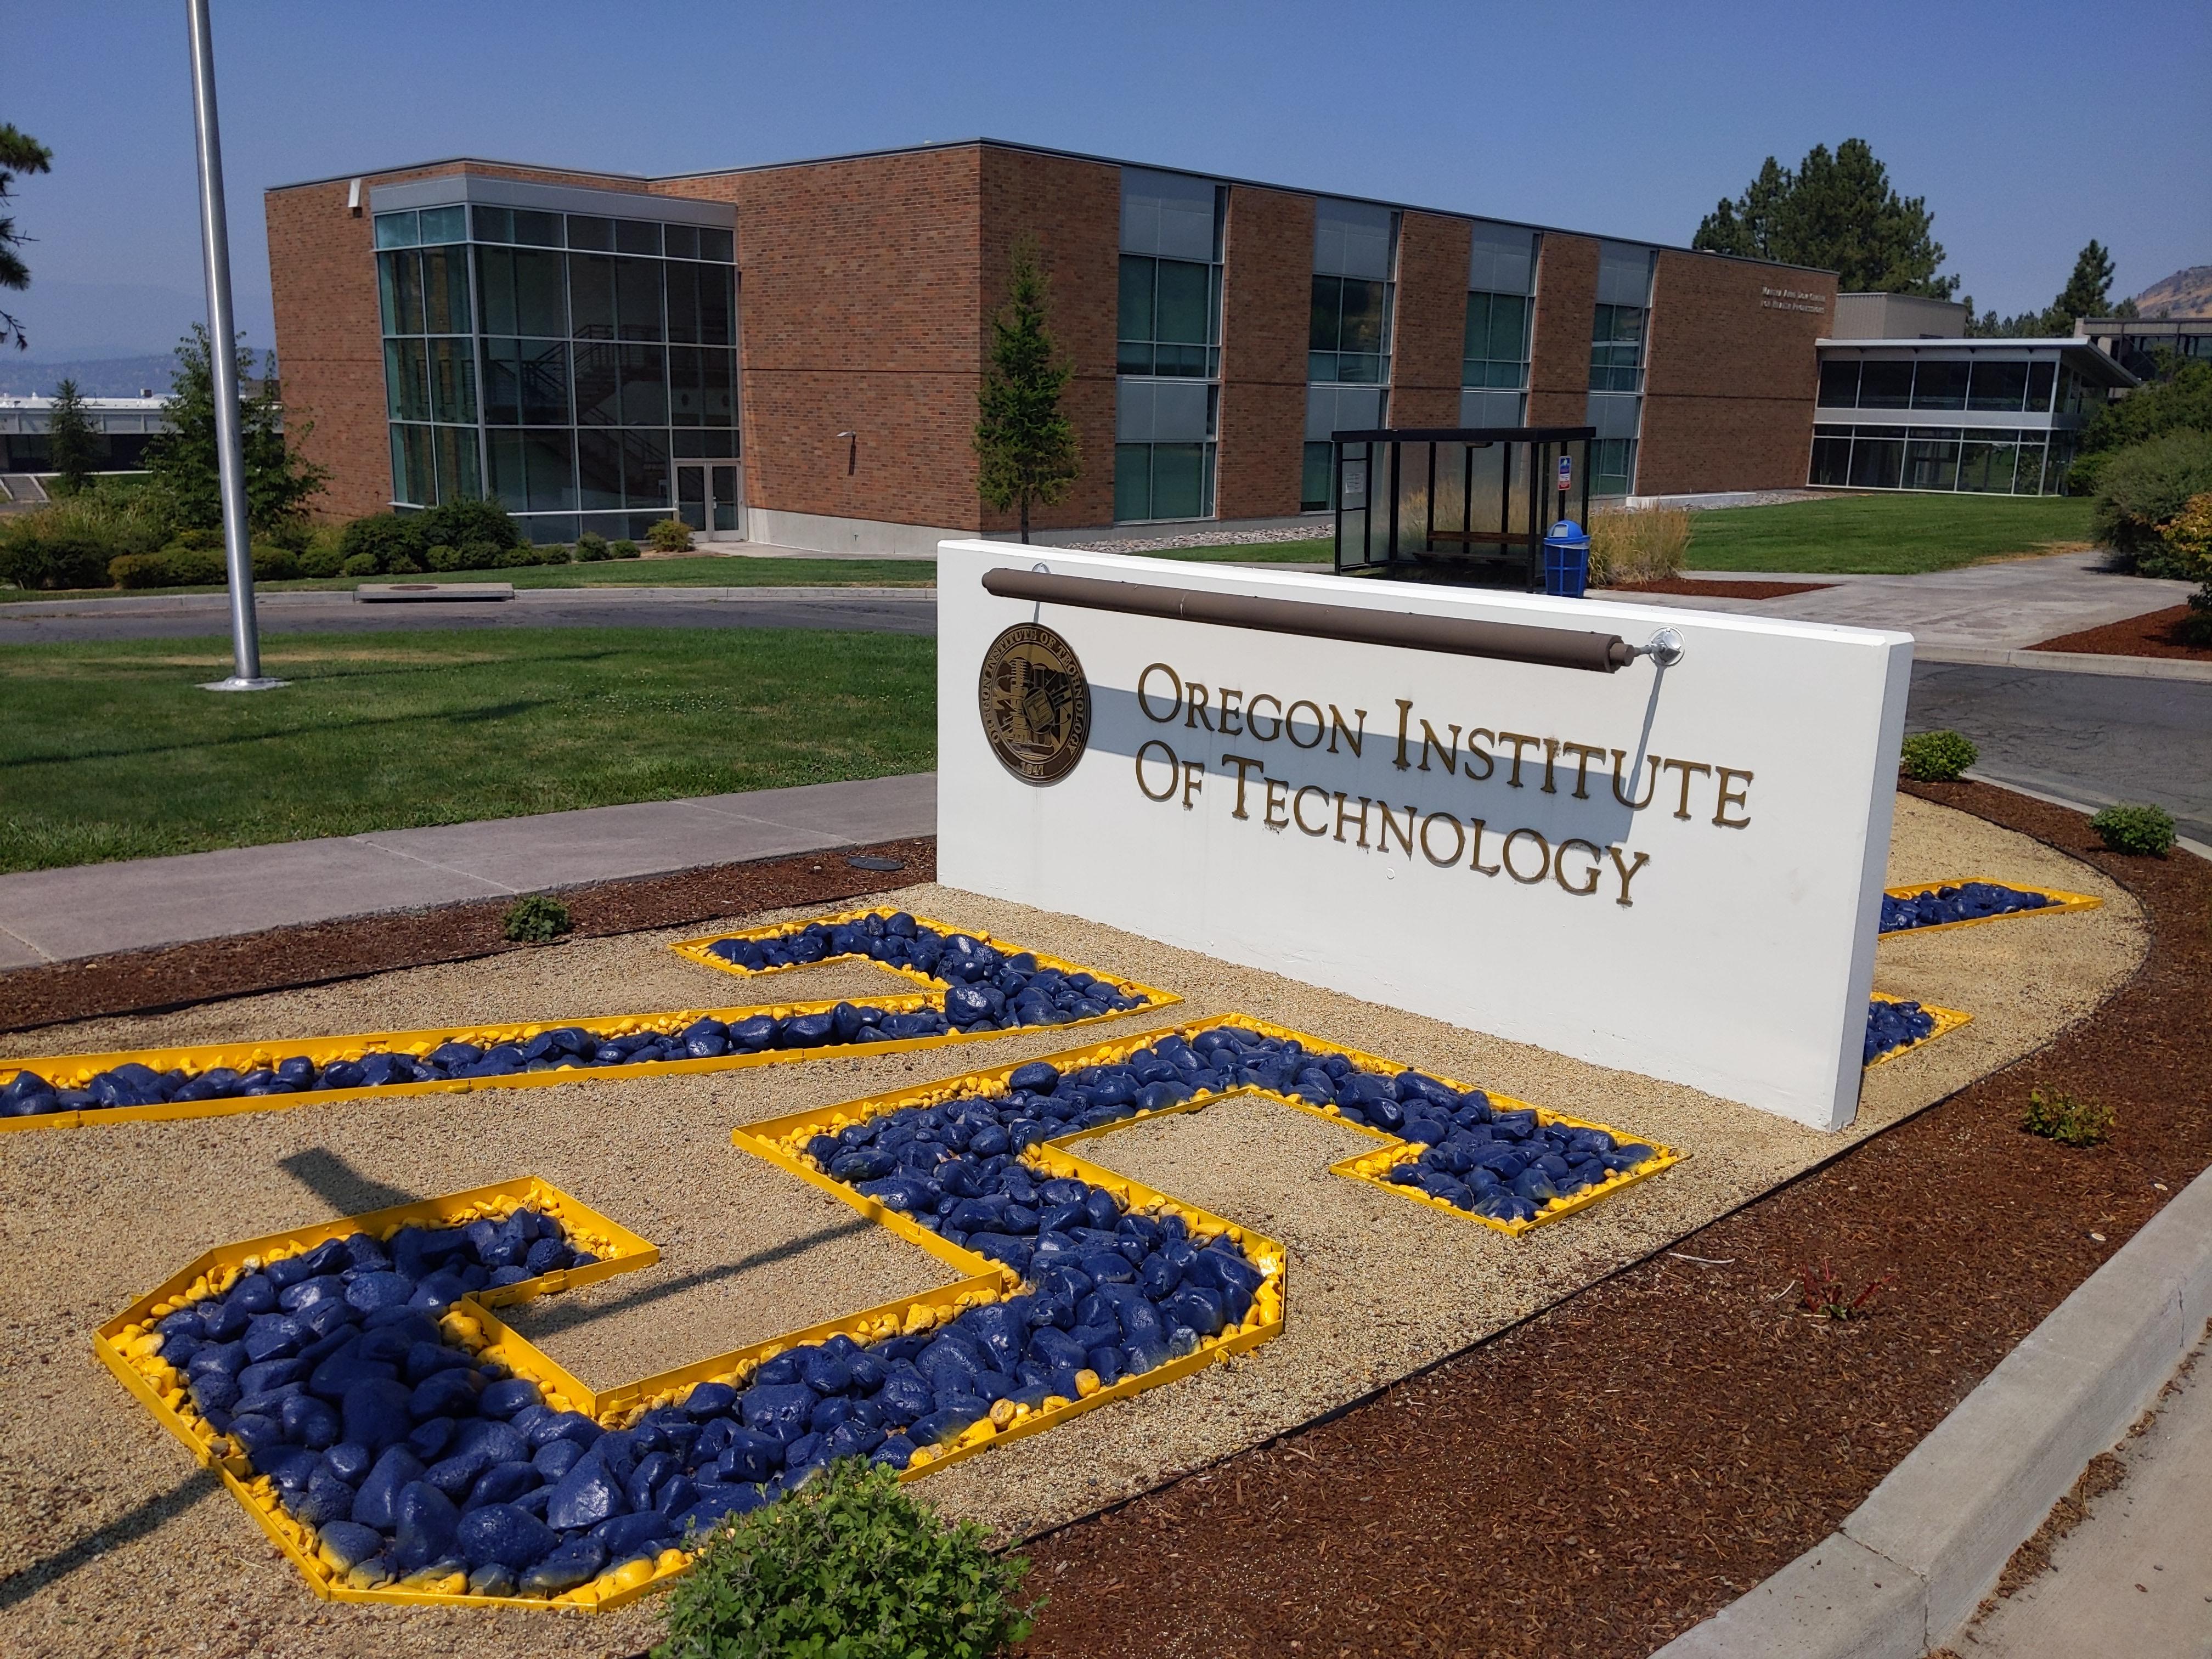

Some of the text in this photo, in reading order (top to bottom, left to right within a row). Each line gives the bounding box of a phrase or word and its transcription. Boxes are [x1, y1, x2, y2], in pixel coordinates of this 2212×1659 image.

[986, 629, 1037, 672] INSTITUTE
[1040, 632, 1056, 648] OF
[1058, 645, 1085, 756] TECHNOLOGY
[1137, 663, 1754, 830] OREGON INSTITUTE
[1020, 761, 1044, 776] 1947
[1136, 740, 1650, 907] OF TECHNOLOGY
